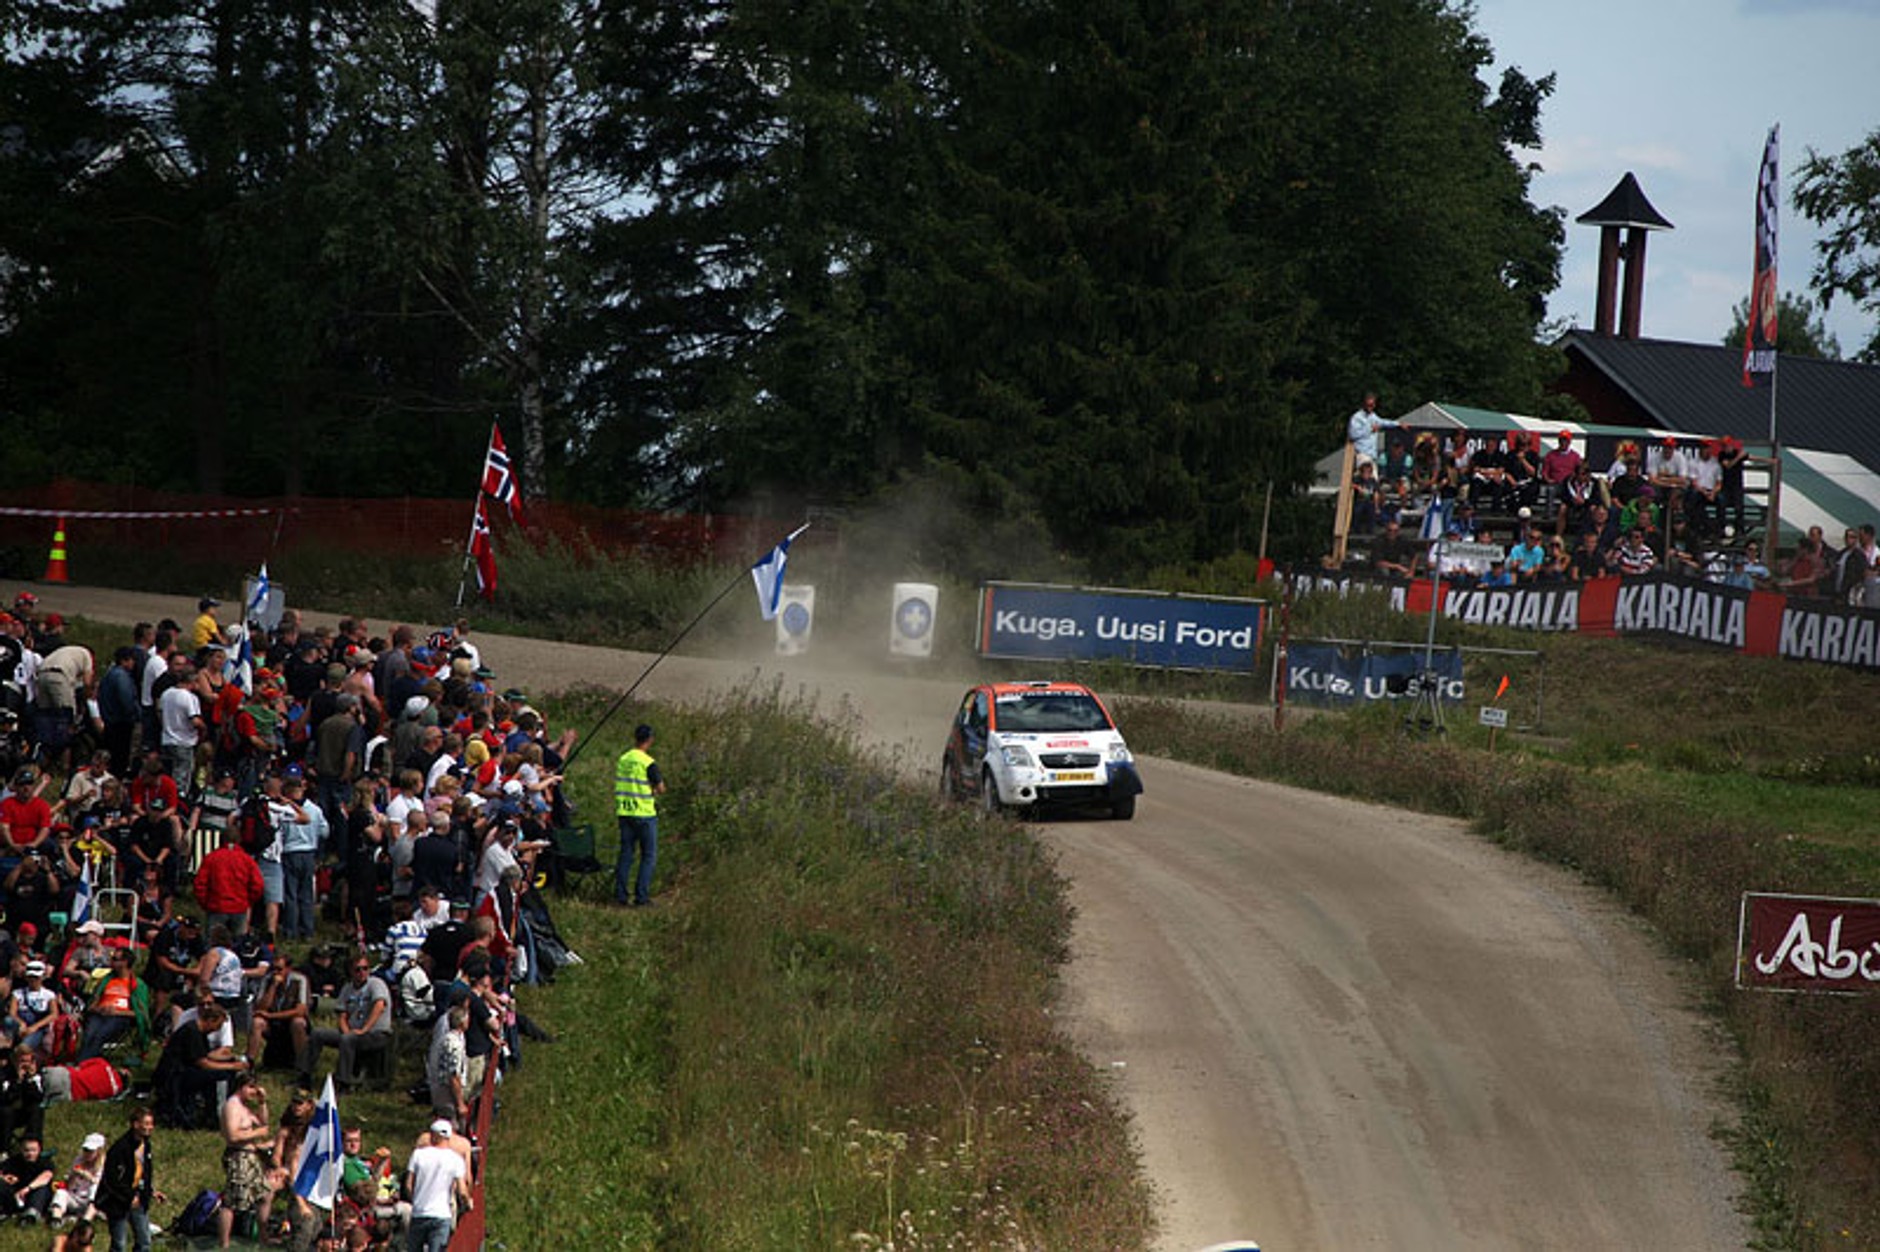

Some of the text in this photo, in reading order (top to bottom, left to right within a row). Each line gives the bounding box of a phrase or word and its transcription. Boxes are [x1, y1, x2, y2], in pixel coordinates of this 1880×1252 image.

[995, 610, 1252, 649] Kuga. Uusi Ford
[1444, 589, 1579, 630] KARJALA
[1614, 583, 1745, 647] KARJALA
[1290, 666, 1354, 694] Kua.
